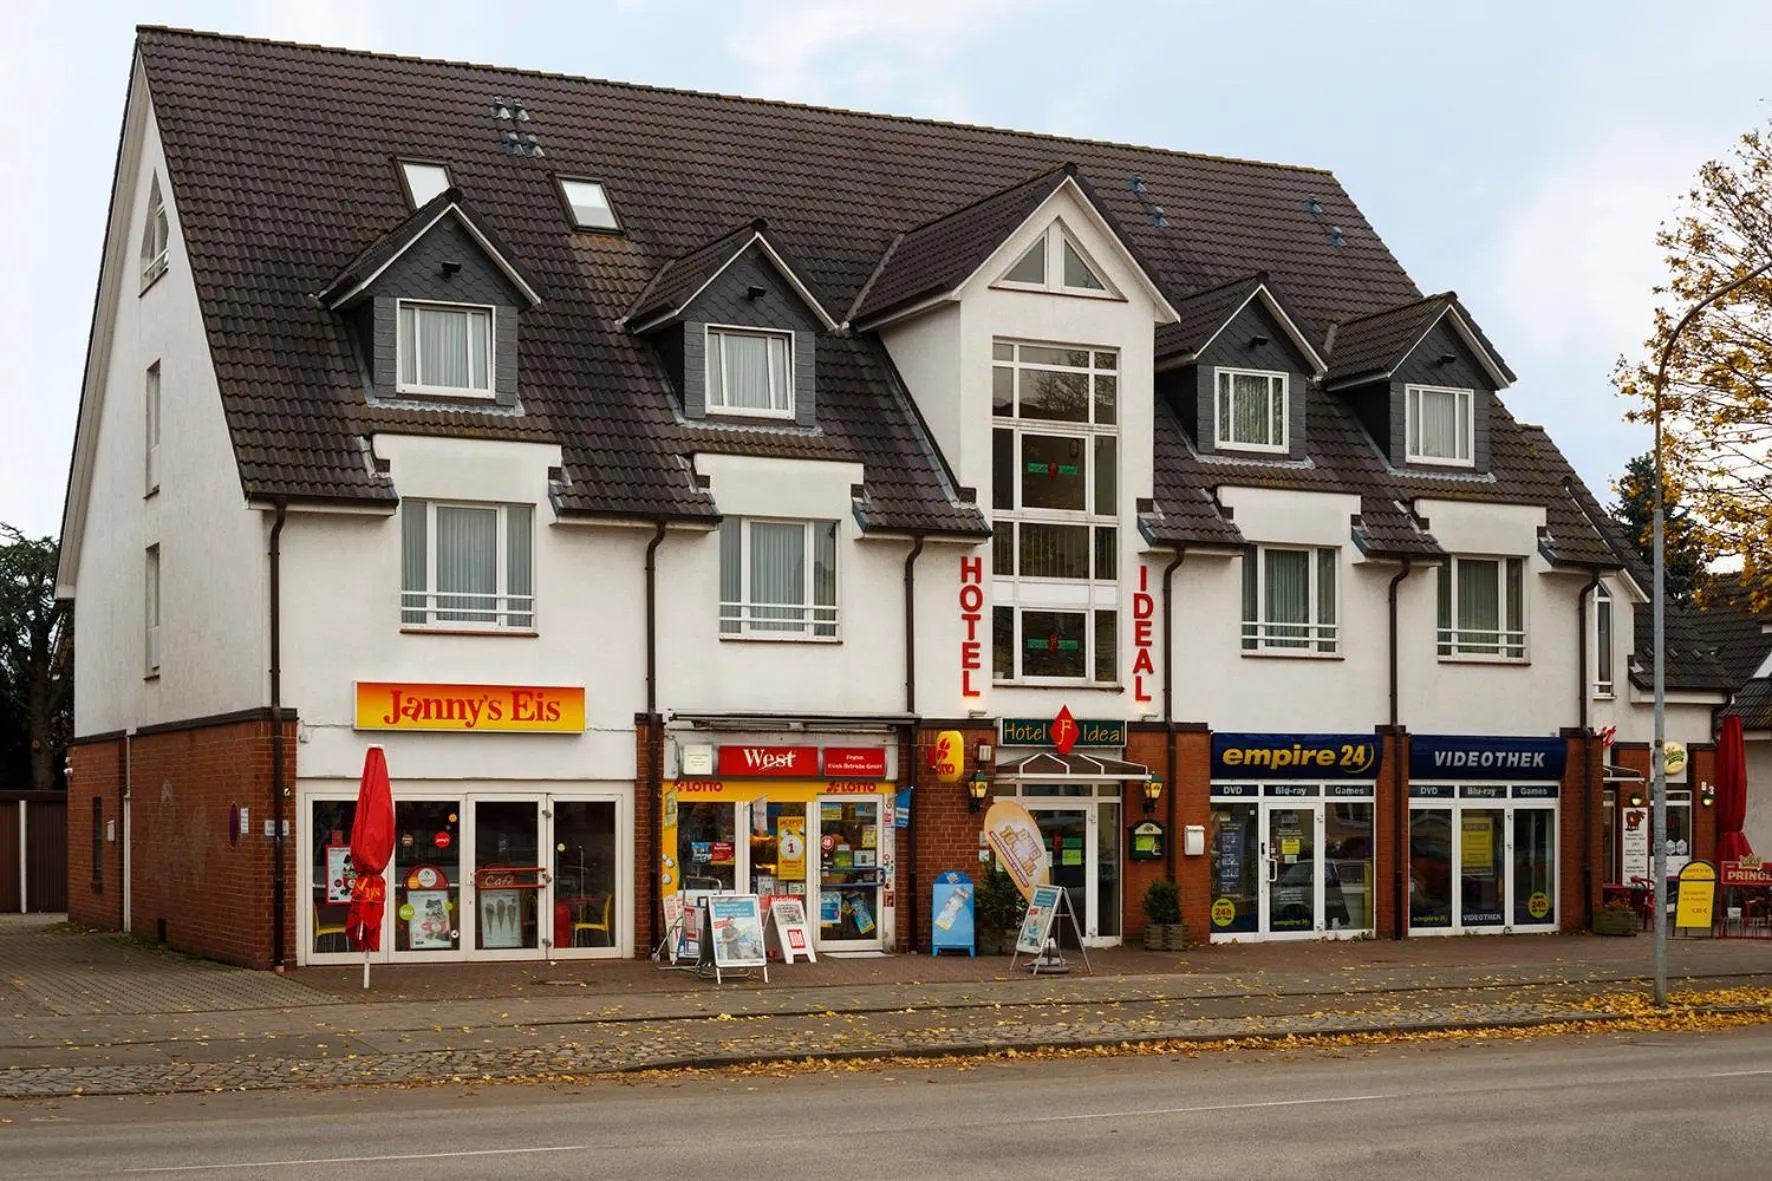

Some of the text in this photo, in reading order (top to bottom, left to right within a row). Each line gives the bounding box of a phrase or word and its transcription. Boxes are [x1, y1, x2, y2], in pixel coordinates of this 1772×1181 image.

[959, 556, 984, 698] HOTEL
[1133, 565, 1155, 702] IDEAL
[384, 690, 562, 728] Janny's Eis
[1004, 721, 1047, 741] Hotel
[1083, 723, 1124, 743] Ideal
[743, 748, 797, 771] West
[1222, 744, 1366, 770] empire 24
[1434, 751, 1546, 768] VIDEOTHEK
[686, 782, 723, 793] LOTTO
[841, 782, 877, 793] LOTTO
[1223, 786, 1243, 795] DVD
[1275, 786, 1308, 797] Blu-ray
[1335, 786, 1365, 795] Games
[1420, 786, 1439, 795] DVD
[1467, 787, 1497, 797] Blu-ray
[1520, 787, 1548, 796] Games
[1214, 907, 1232, 916] 24h
[1462, 913, 1503, 921] VIDEOTHEK
